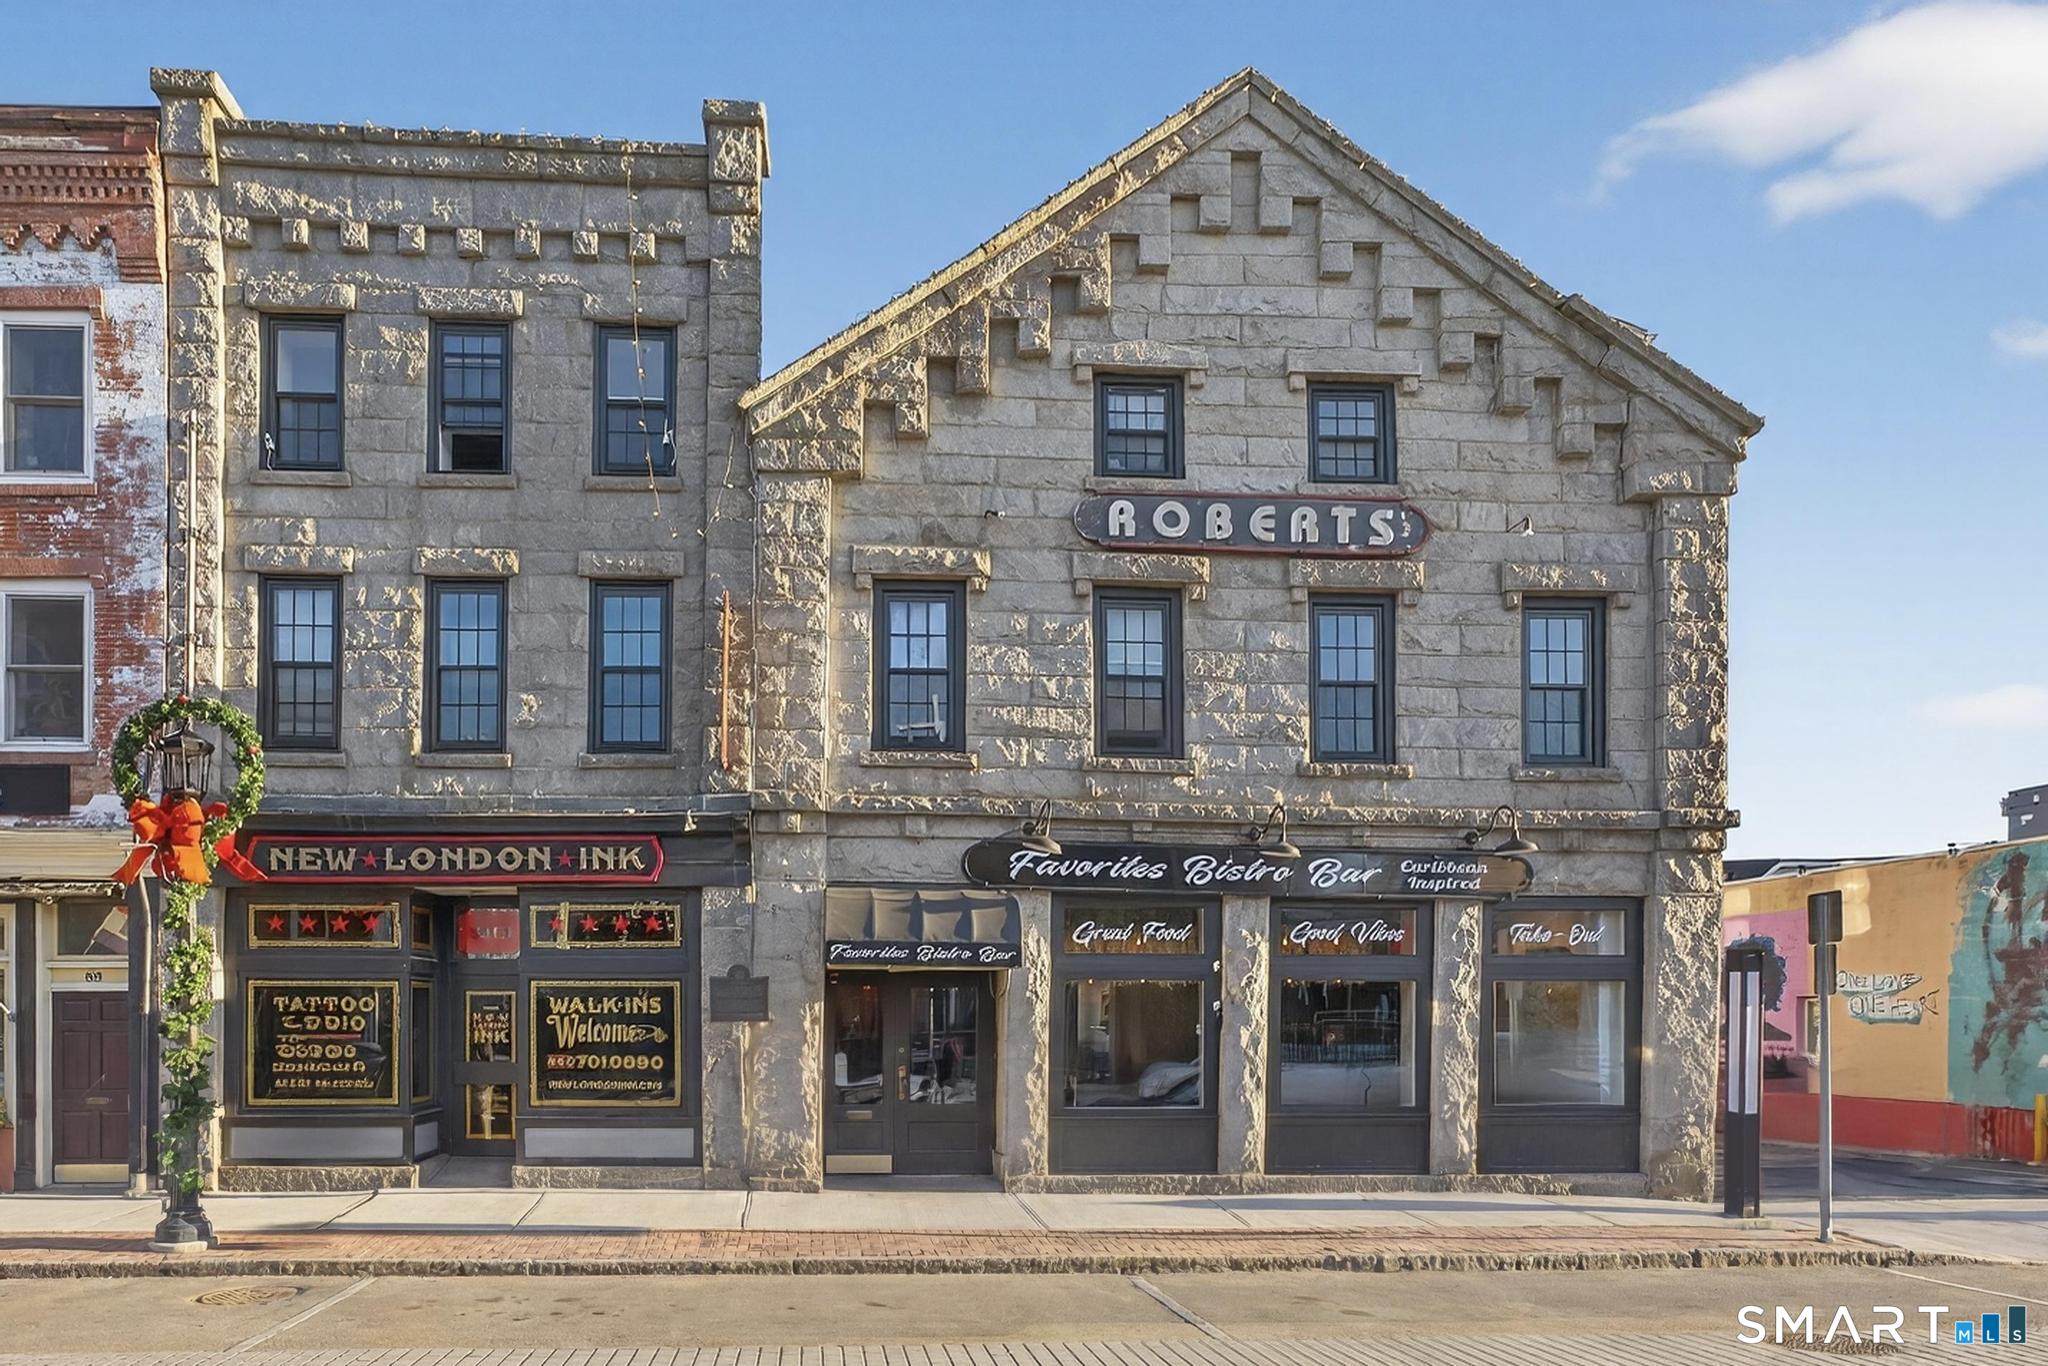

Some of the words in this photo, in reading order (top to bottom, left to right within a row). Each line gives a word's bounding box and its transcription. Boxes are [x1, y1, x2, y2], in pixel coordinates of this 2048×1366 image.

[1108, 499, 1395, 546] ROBERTS
[269, 847, 357, 871] NEW
[385, 846, 551, 872] LONDON
[579, 846, 646, 871] INK
[1009, 849, 1168, 881] Favorites
[1183, 854, 1294, 886] Bistro
[1307, 858, 1383, 888] Bar
[1142, 921, 1193, 944] Food
[273, 995, 376, 1013] TATTOO
